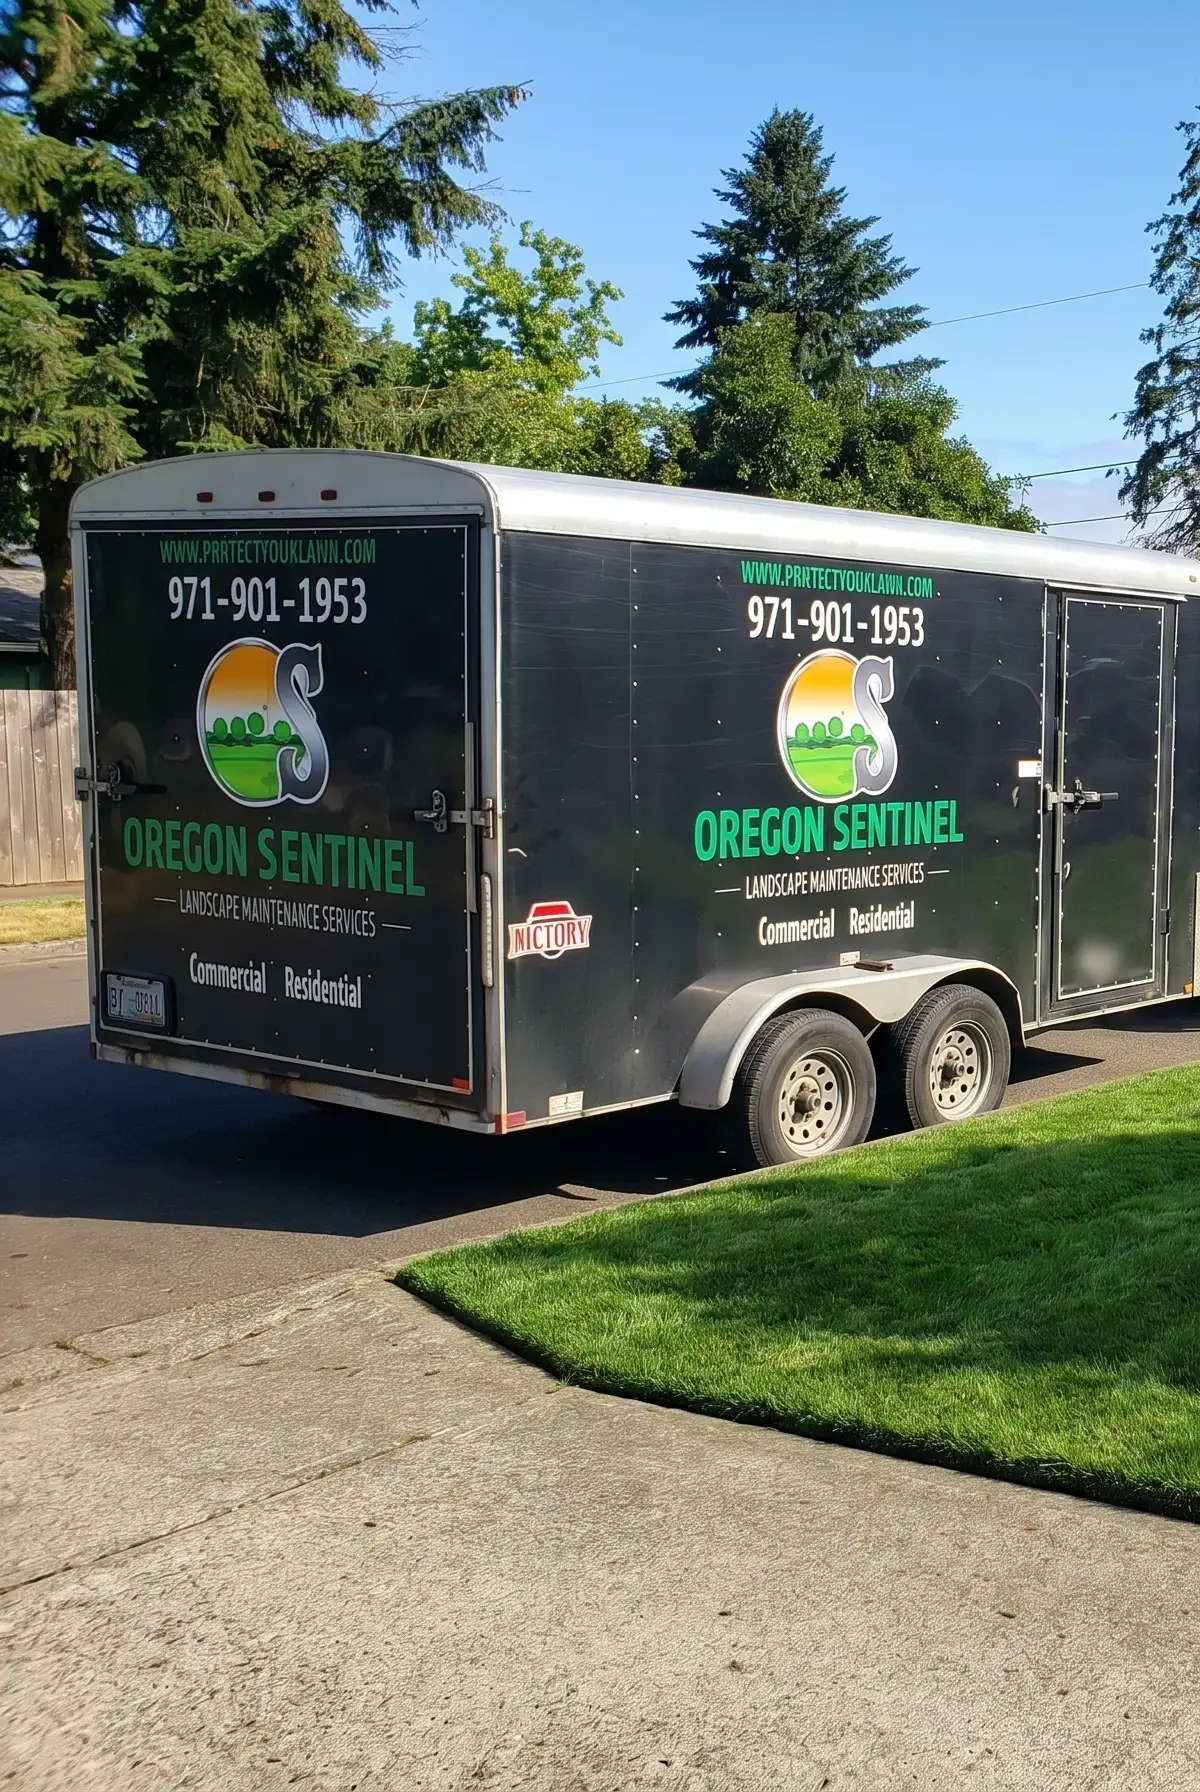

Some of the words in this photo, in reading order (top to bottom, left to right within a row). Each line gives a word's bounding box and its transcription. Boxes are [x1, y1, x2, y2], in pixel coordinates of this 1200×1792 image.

[168, 576, 367, 624] 971-901-1953
[748, 595, 925, 647] 971-901-1953
[694, 806, 824, 862] OREGON
[833, 799, 964, 851] SENTINEL
[124, 817, 248, 877] OREGON
[257, 828, 426, 897] SENTINEL
[745, 871, 808, 900] LANDSCAPE
[810, 865, 881, 894] MAINTENANCE
[881, 862, 925, 887] SERVICES
[179, 888, 240, 920] LANDSCAPE
[241, 897, 320, 931] MAINTENANCE
[322, 905, 376, 938] SERVICES
[758, 908, 835, 946] Commercial
[849, 900, 915, 935] Residential
[189, 952, 267, 994] Commercial
[284, 965, 362, 1009] Residential
